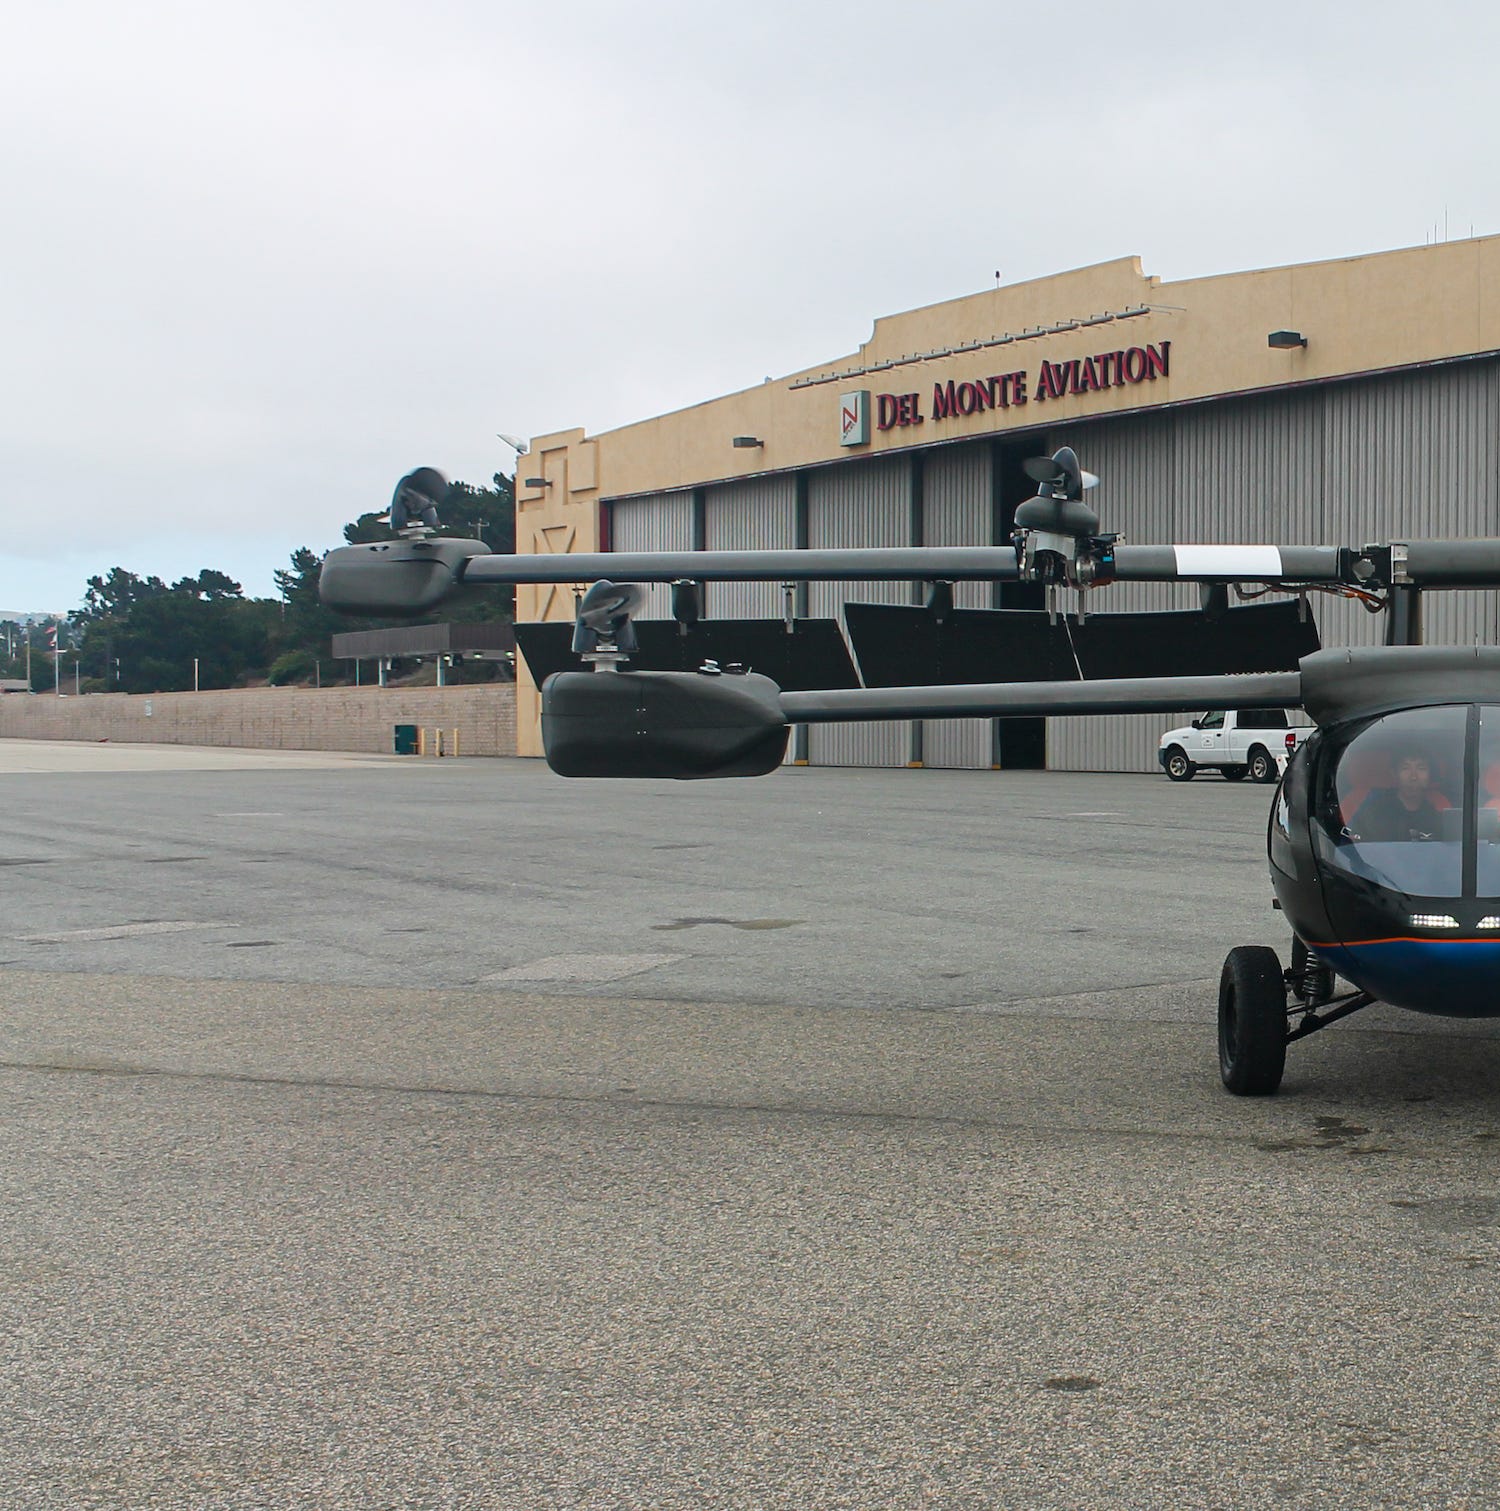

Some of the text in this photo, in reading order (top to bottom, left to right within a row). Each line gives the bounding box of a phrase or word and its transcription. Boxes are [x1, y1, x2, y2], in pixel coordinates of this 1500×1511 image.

[876, 341, 1171, 431] DEL MONTE AVIATION
